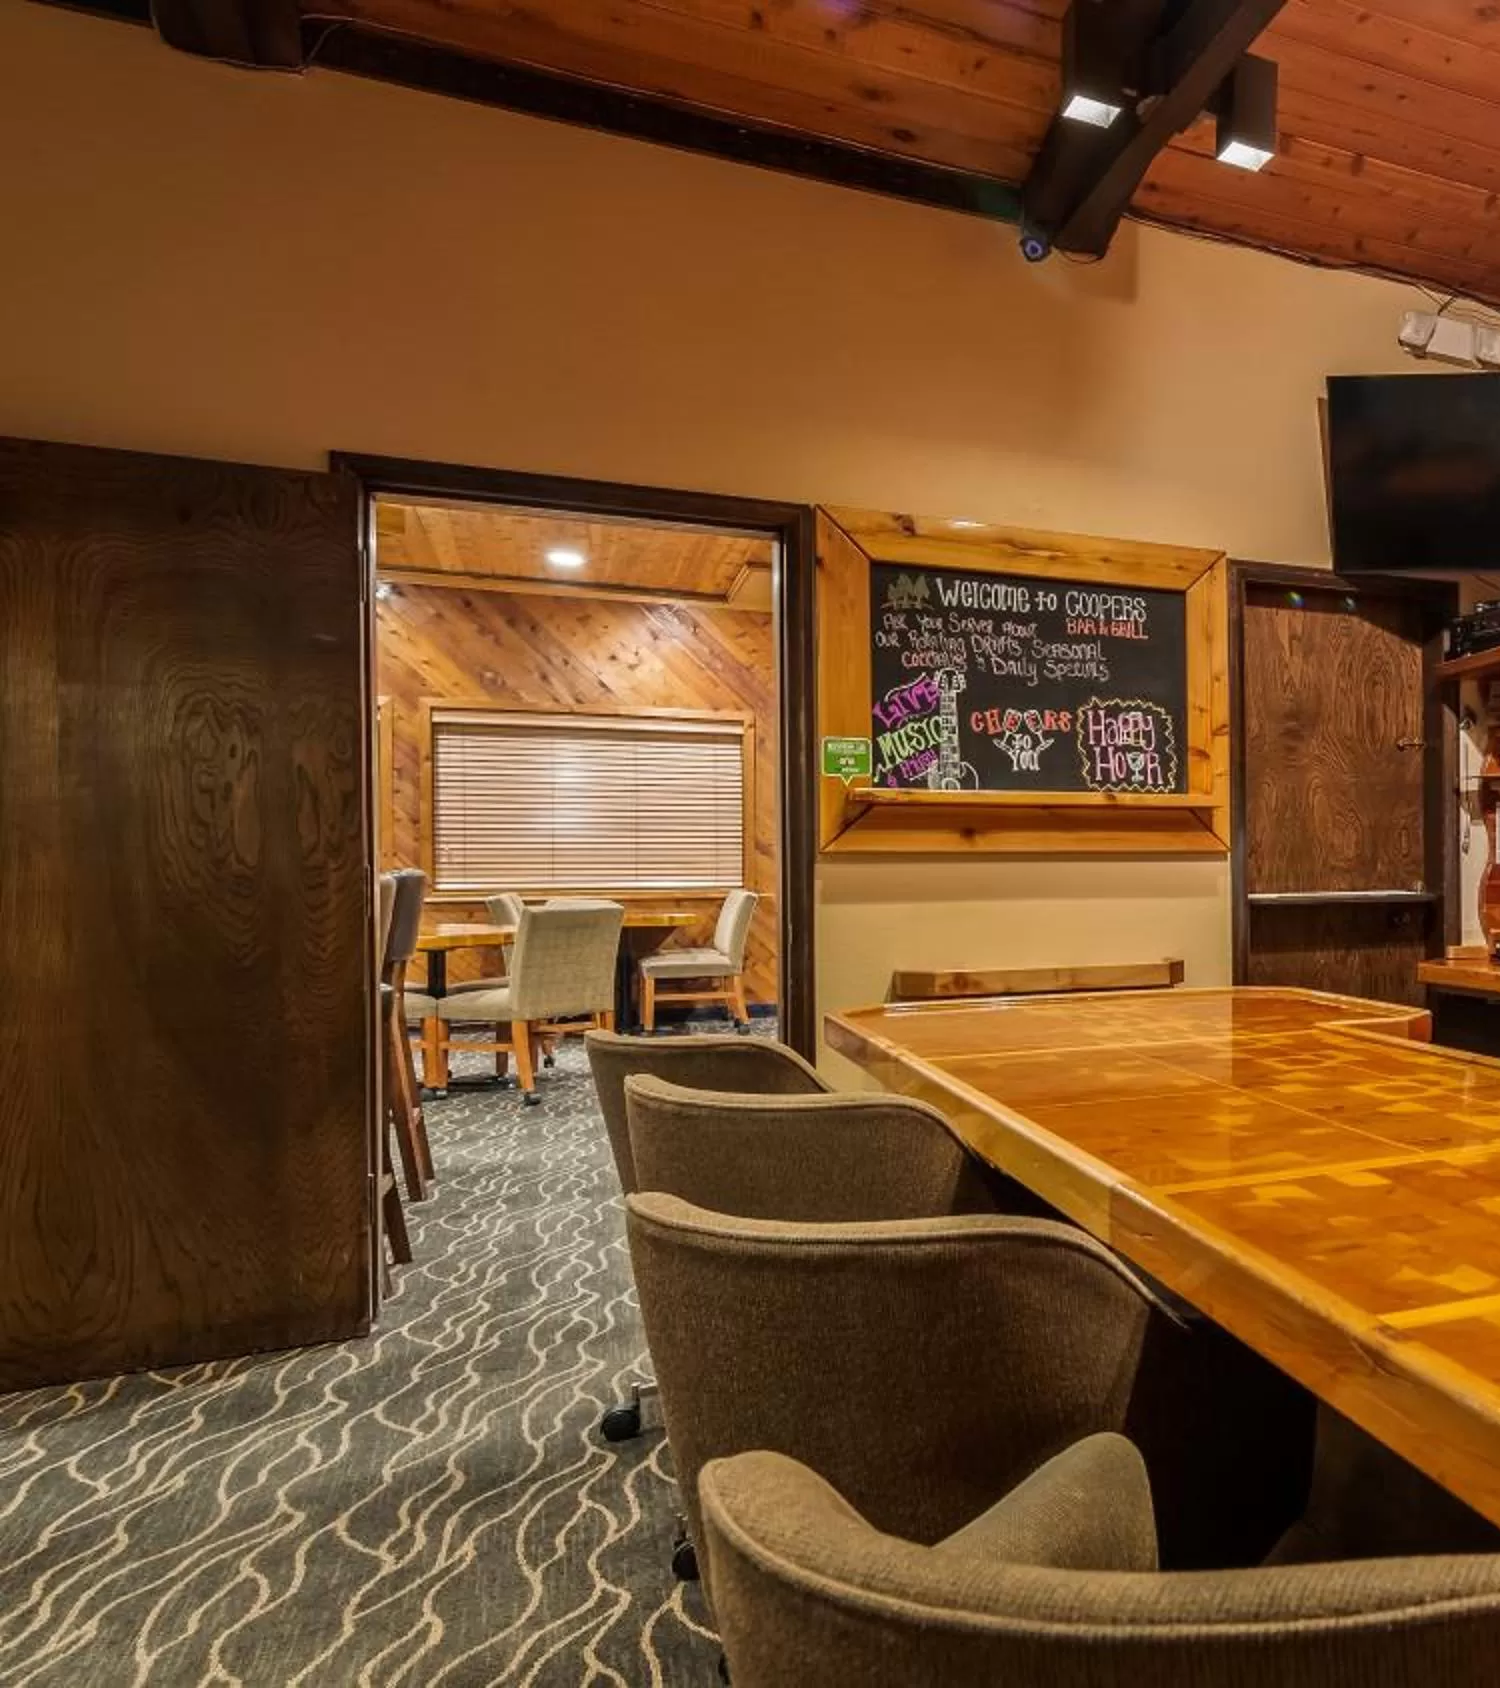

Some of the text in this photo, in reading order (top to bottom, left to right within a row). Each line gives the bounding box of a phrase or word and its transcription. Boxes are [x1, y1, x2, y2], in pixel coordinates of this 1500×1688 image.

[936, 577, 1030, 613] Welcome
[1066, 617, 1097, 635] BAR
[1110, 620, 1149, 640] GRILL
